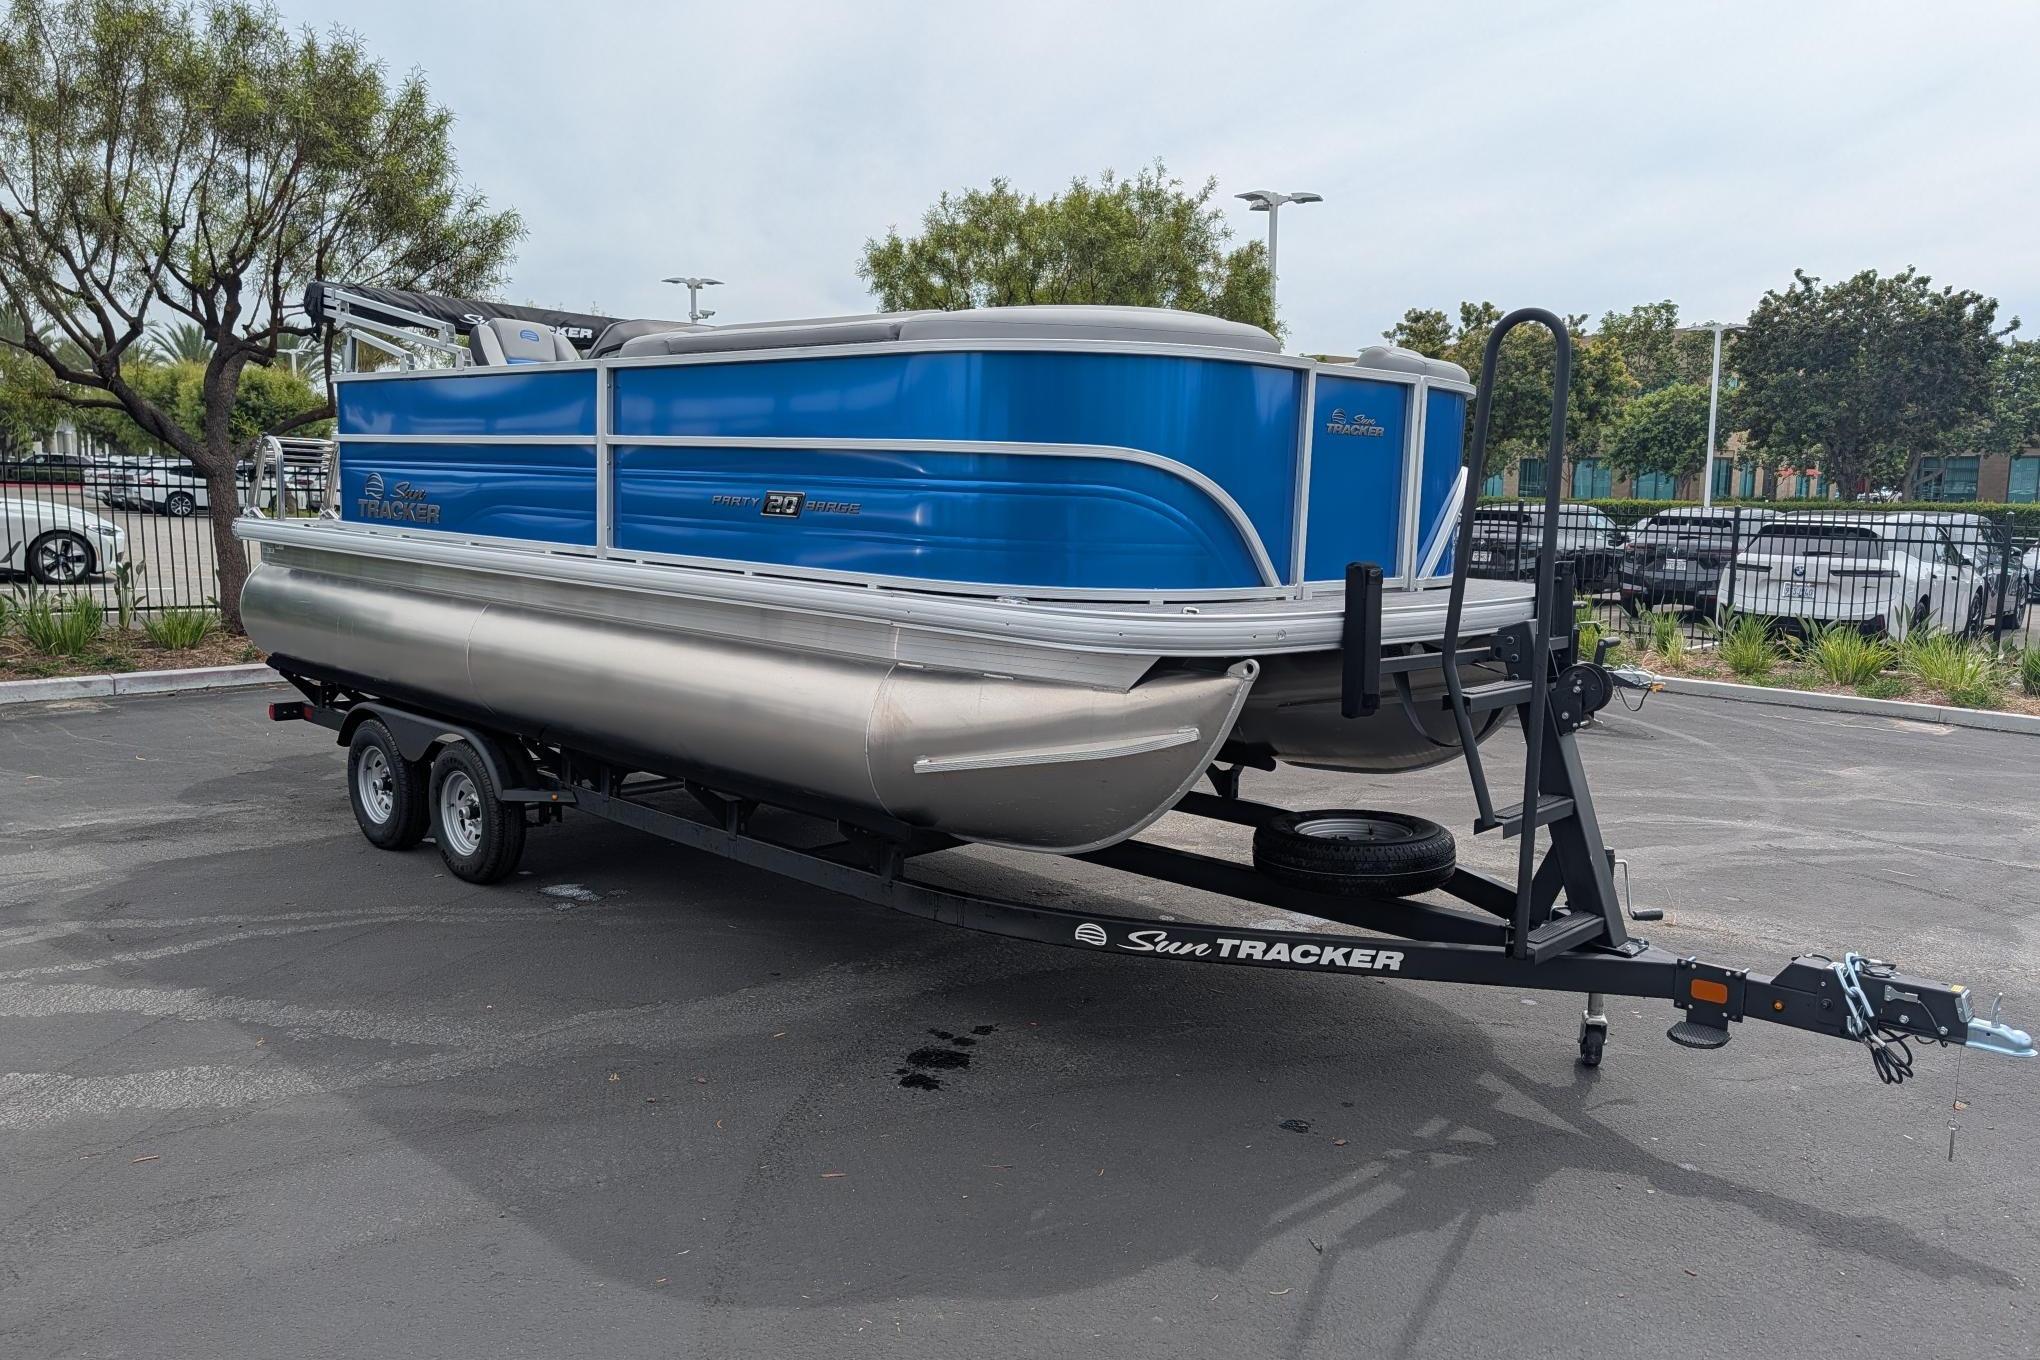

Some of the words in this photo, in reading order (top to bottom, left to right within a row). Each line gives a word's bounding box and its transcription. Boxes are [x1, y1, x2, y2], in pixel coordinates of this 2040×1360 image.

[1326, 423, 1385, 437] TRACKER
[1351, 414, 1376, 426] Sun
[390, 481, 426, 501] Sun
[358, 498, 440, 525] TRACKER
[711, 495, 760, 508] PARTY
[766, 495, 799, 514] 20
[805, 500, 863, 515] BARGE
[1117, 930, 1212, 957] Sun
[1217, 938, 1405, 971] TRACKER
